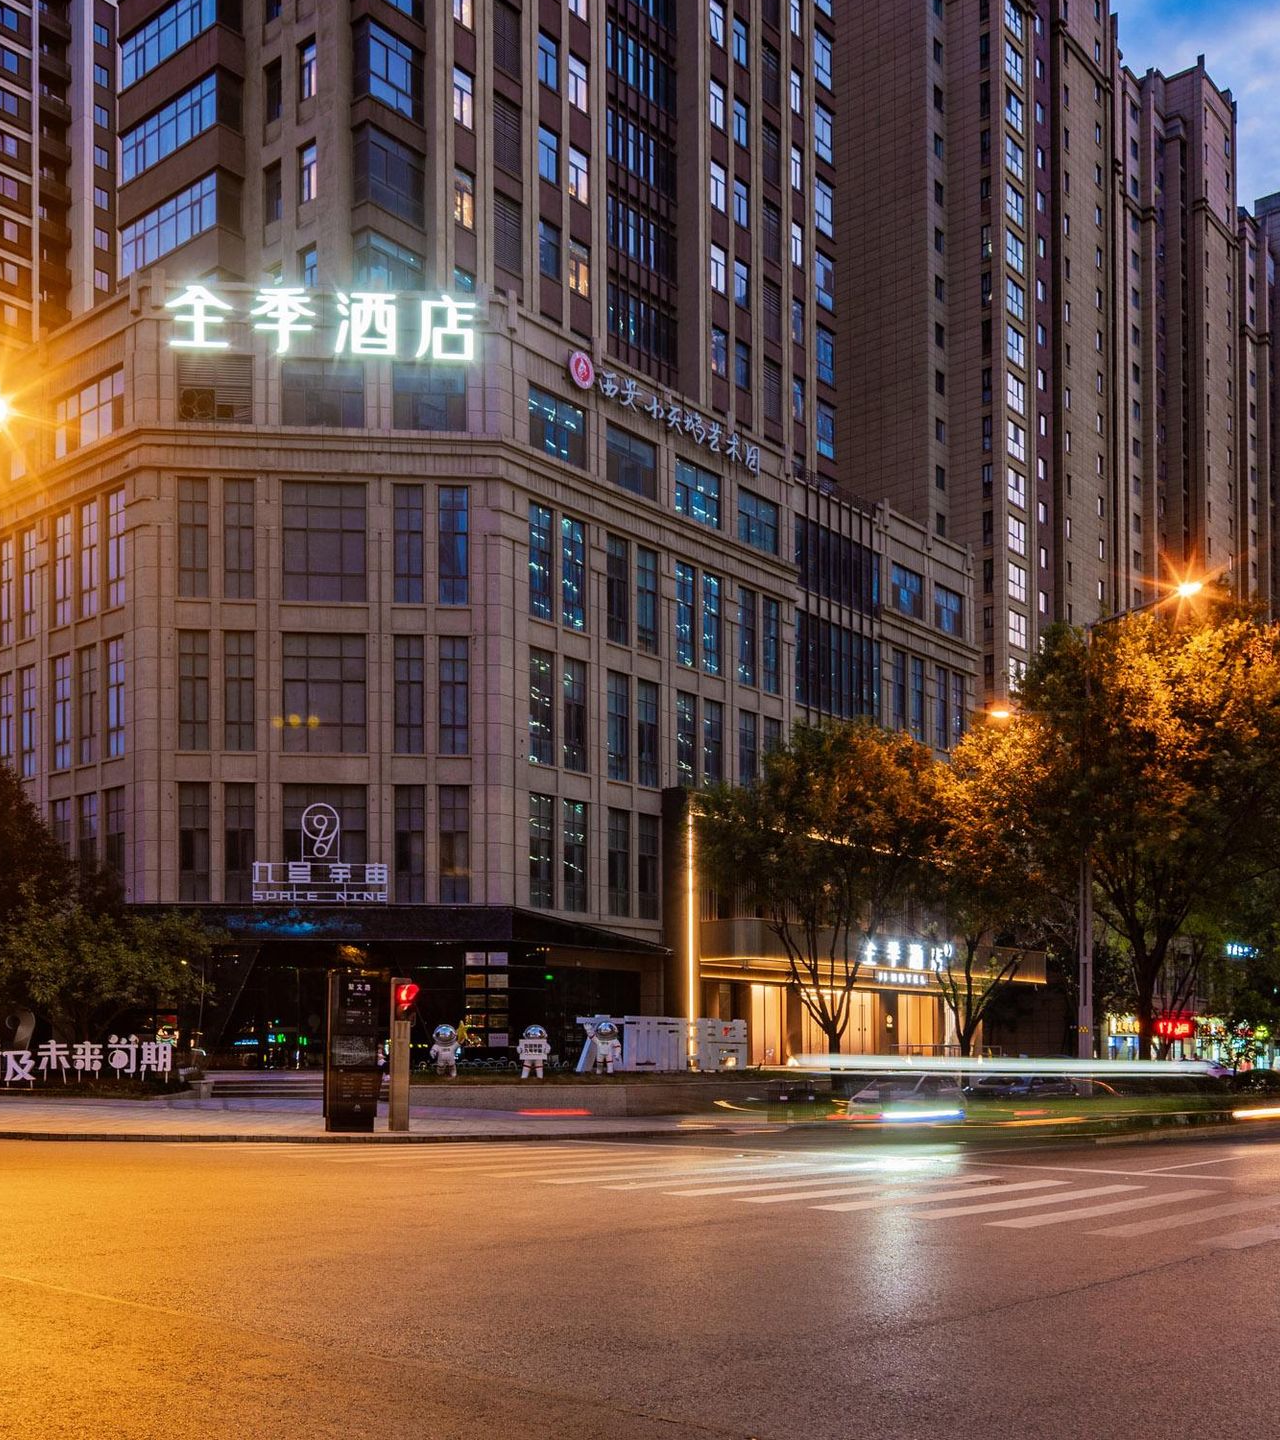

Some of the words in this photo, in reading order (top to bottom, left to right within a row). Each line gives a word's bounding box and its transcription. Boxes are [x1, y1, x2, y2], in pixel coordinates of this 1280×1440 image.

[165, 285, 477, 361] 全季酒店
[253, 862, 388, 884] 九号宇宙
[253, 891, 318, 902] SPACE
[336, 891, 388, 902] NINE
[891, 973, 926, 985] HOTEL
